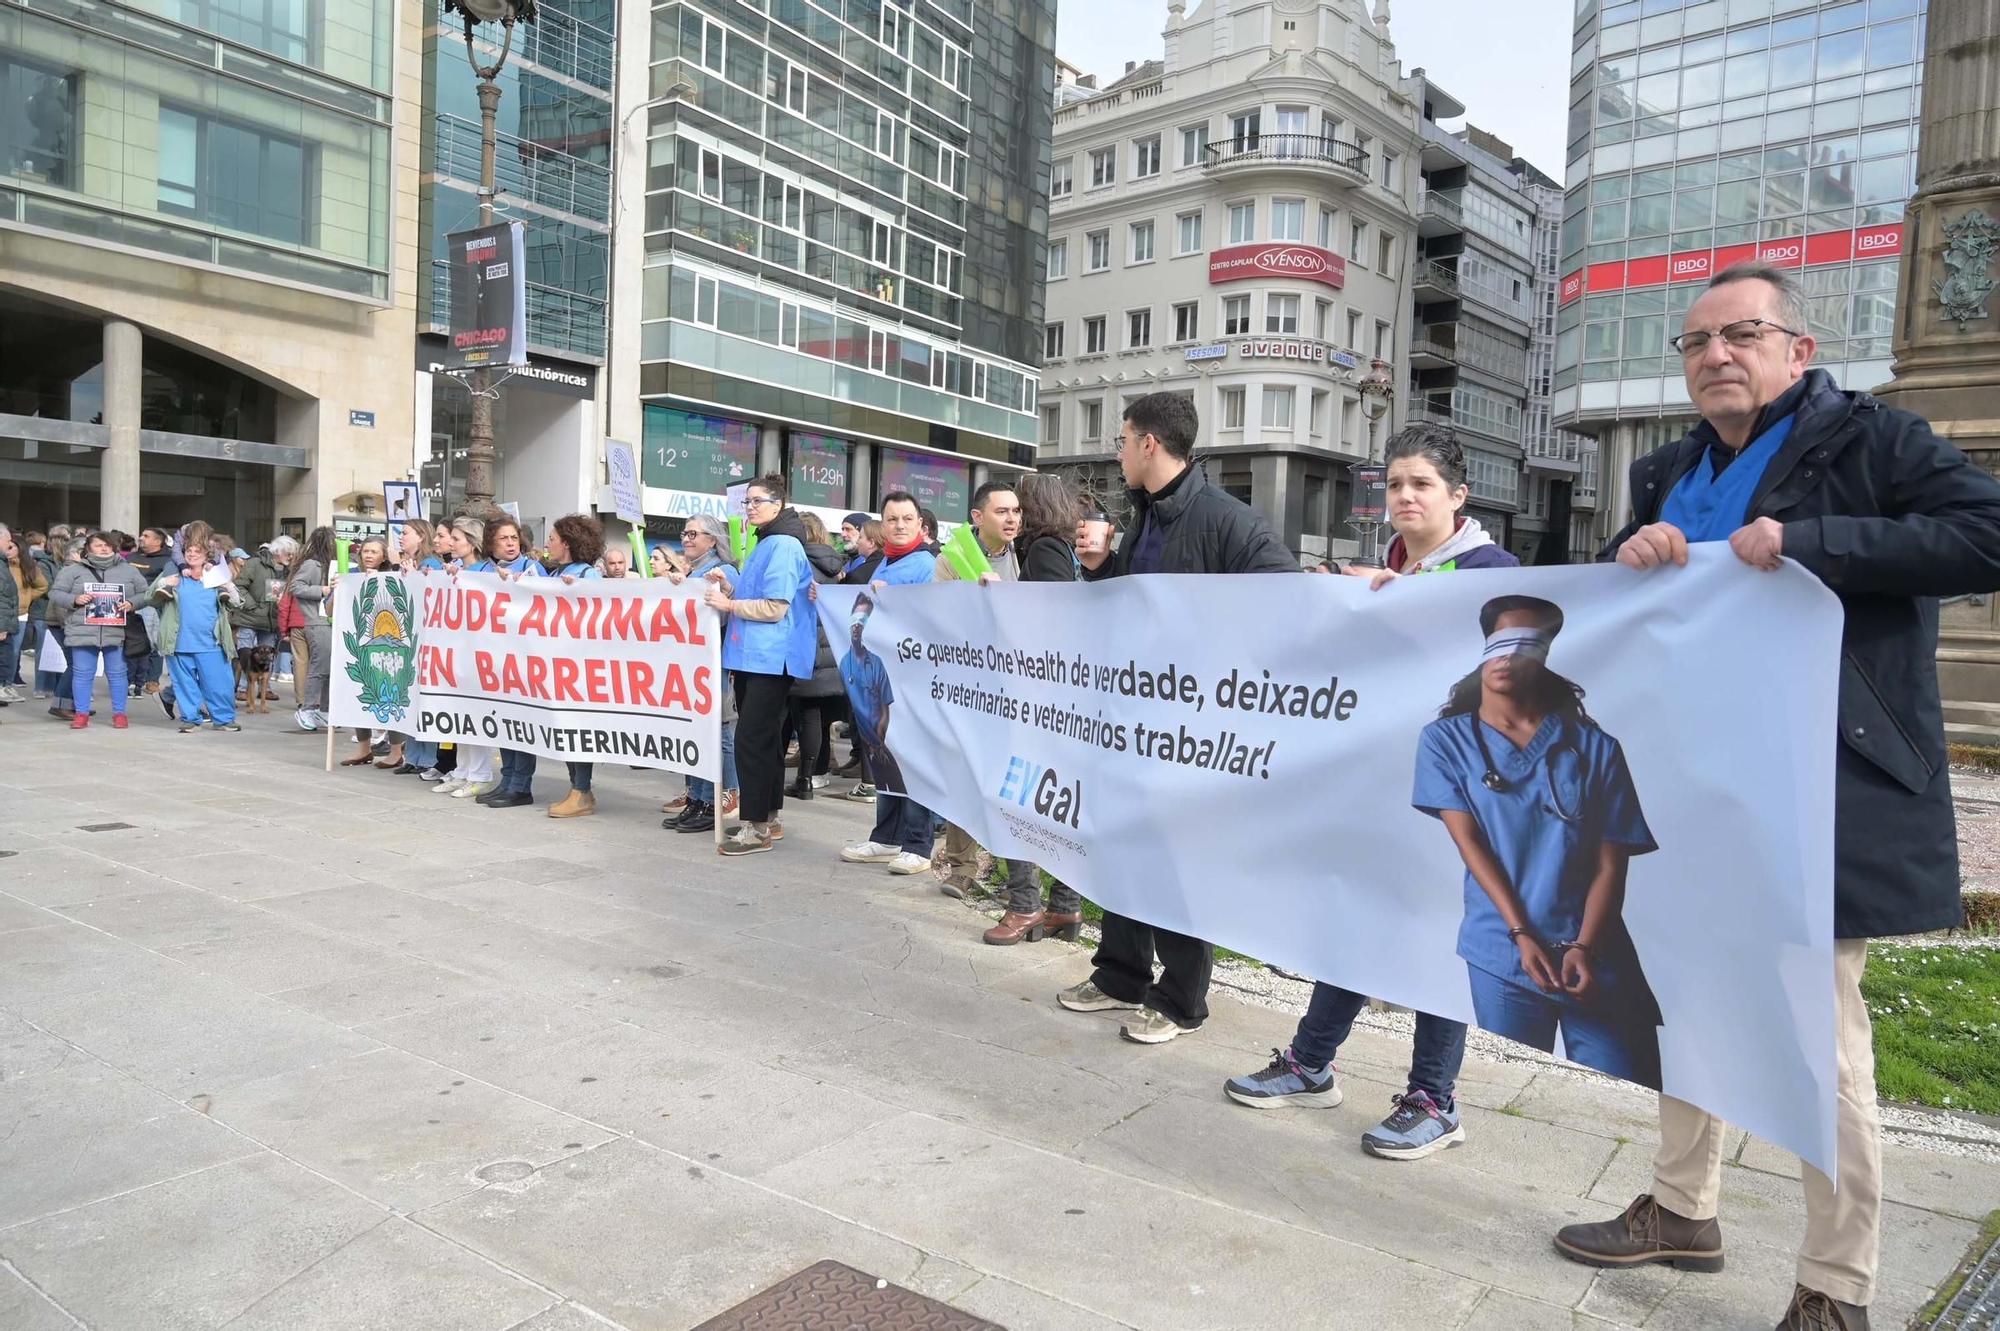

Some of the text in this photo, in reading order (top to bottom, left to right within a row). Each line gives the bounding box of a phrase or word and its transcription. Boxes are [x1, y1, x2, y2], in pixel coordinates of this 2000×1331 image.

[1863, 233, 1898, 248] BDO
[1211, 254, 1321, 270] CENTRO CAPILAR SVENSON
[1767, 245, 1799, 261] BDO
[1677, 257, 1708, 271] BDO
[1565, 277, 1579, 292] BDO
[455, 328, 506, 347] CHICAGO
[1186, 345, 1226, 359] ASESORIA
[1242, 342, 1323, 358] avante
[801, 464, 844, 487] 11:29h
[677, 495, 729, 518] ABAN
[423, 576, 705, 646] SAÚDE ANIMAL
[476, 651, 713, 715] BARREIRAS
[897, 637, 1358, 721] ¡Se queredes One Health de verdade, deixade
[931, 675, 1276, 780] ás veterinarias e veterinarios traballar!
[482, 710, 499, 738] Ó
[502, 718, 535, 745] TEU
[539, 724, 700, 767] VETERINARIO
